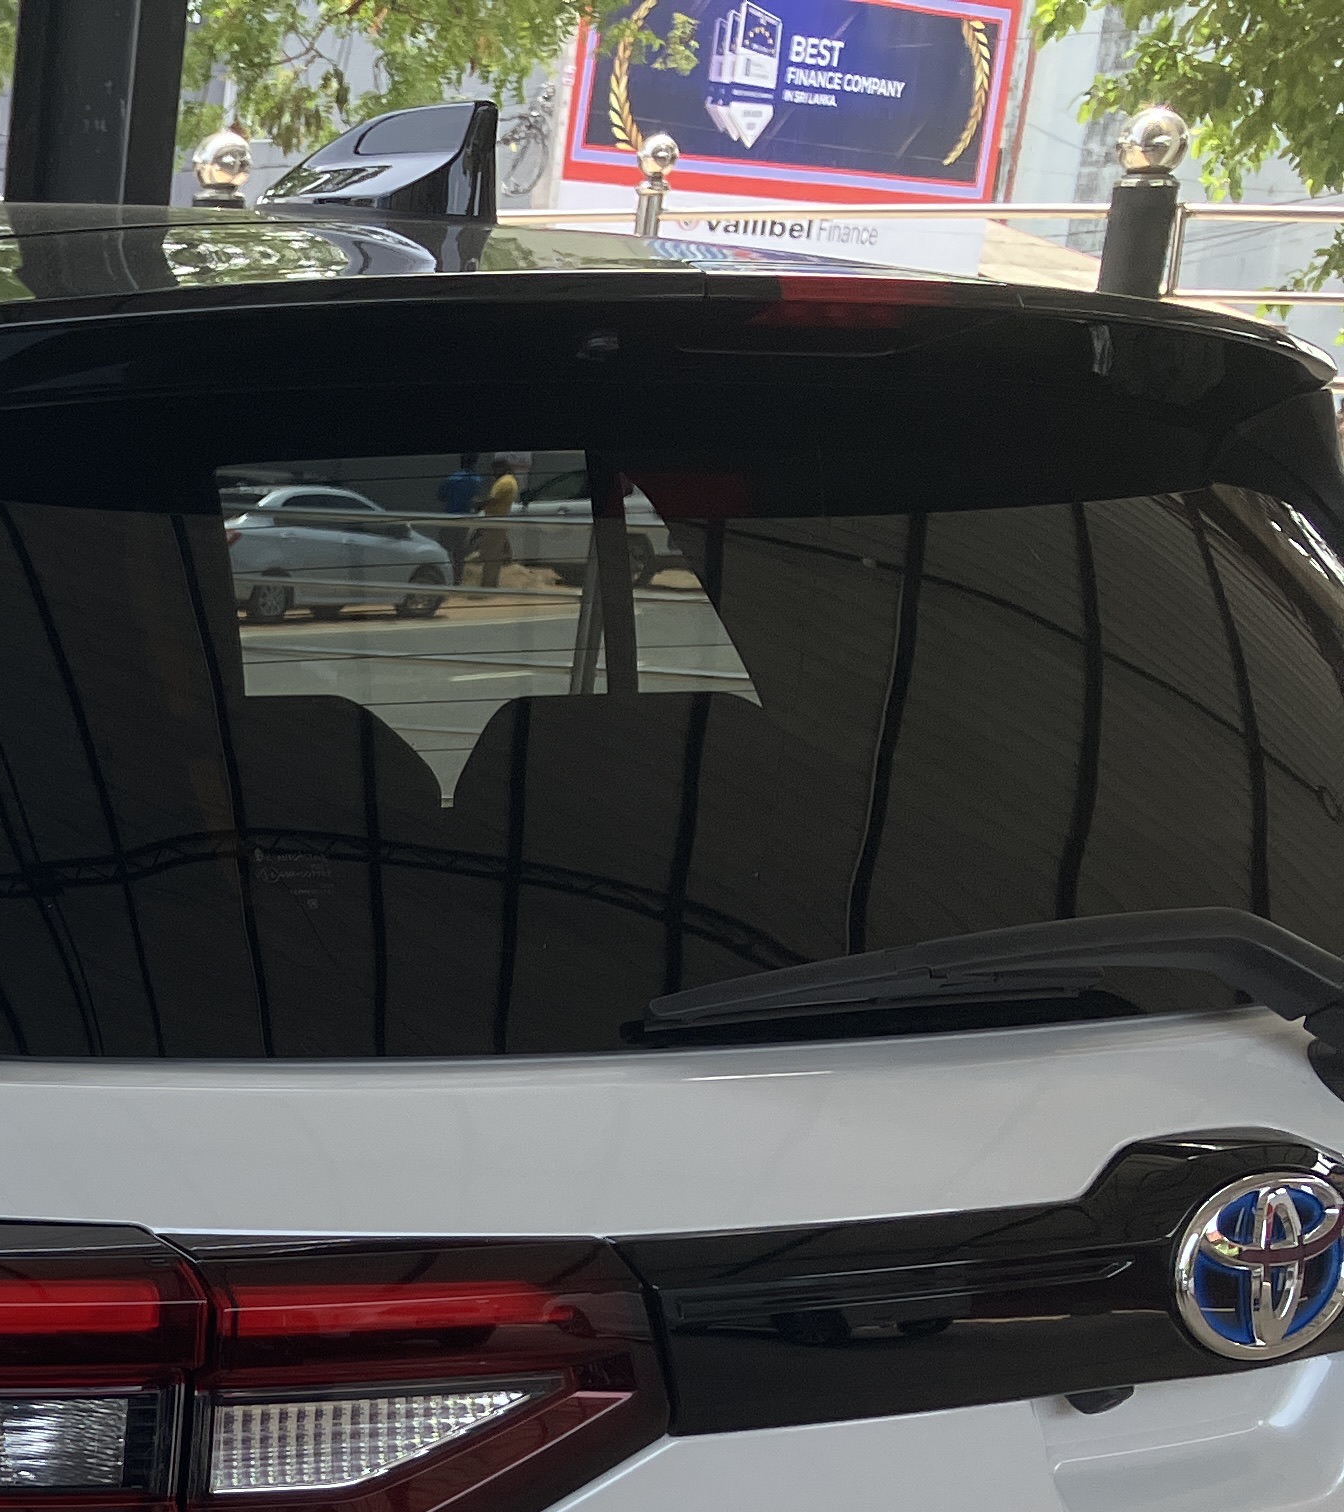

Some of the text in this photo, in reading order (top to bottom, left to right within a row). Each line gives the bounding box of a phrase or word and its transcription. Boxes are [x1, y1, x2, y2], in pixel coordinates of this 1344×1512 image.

[789, 35, 845, 67] BEST
[785, 66, 906, 98] FINANCE COMPANY
[816, 219, 879, 246] Finance
